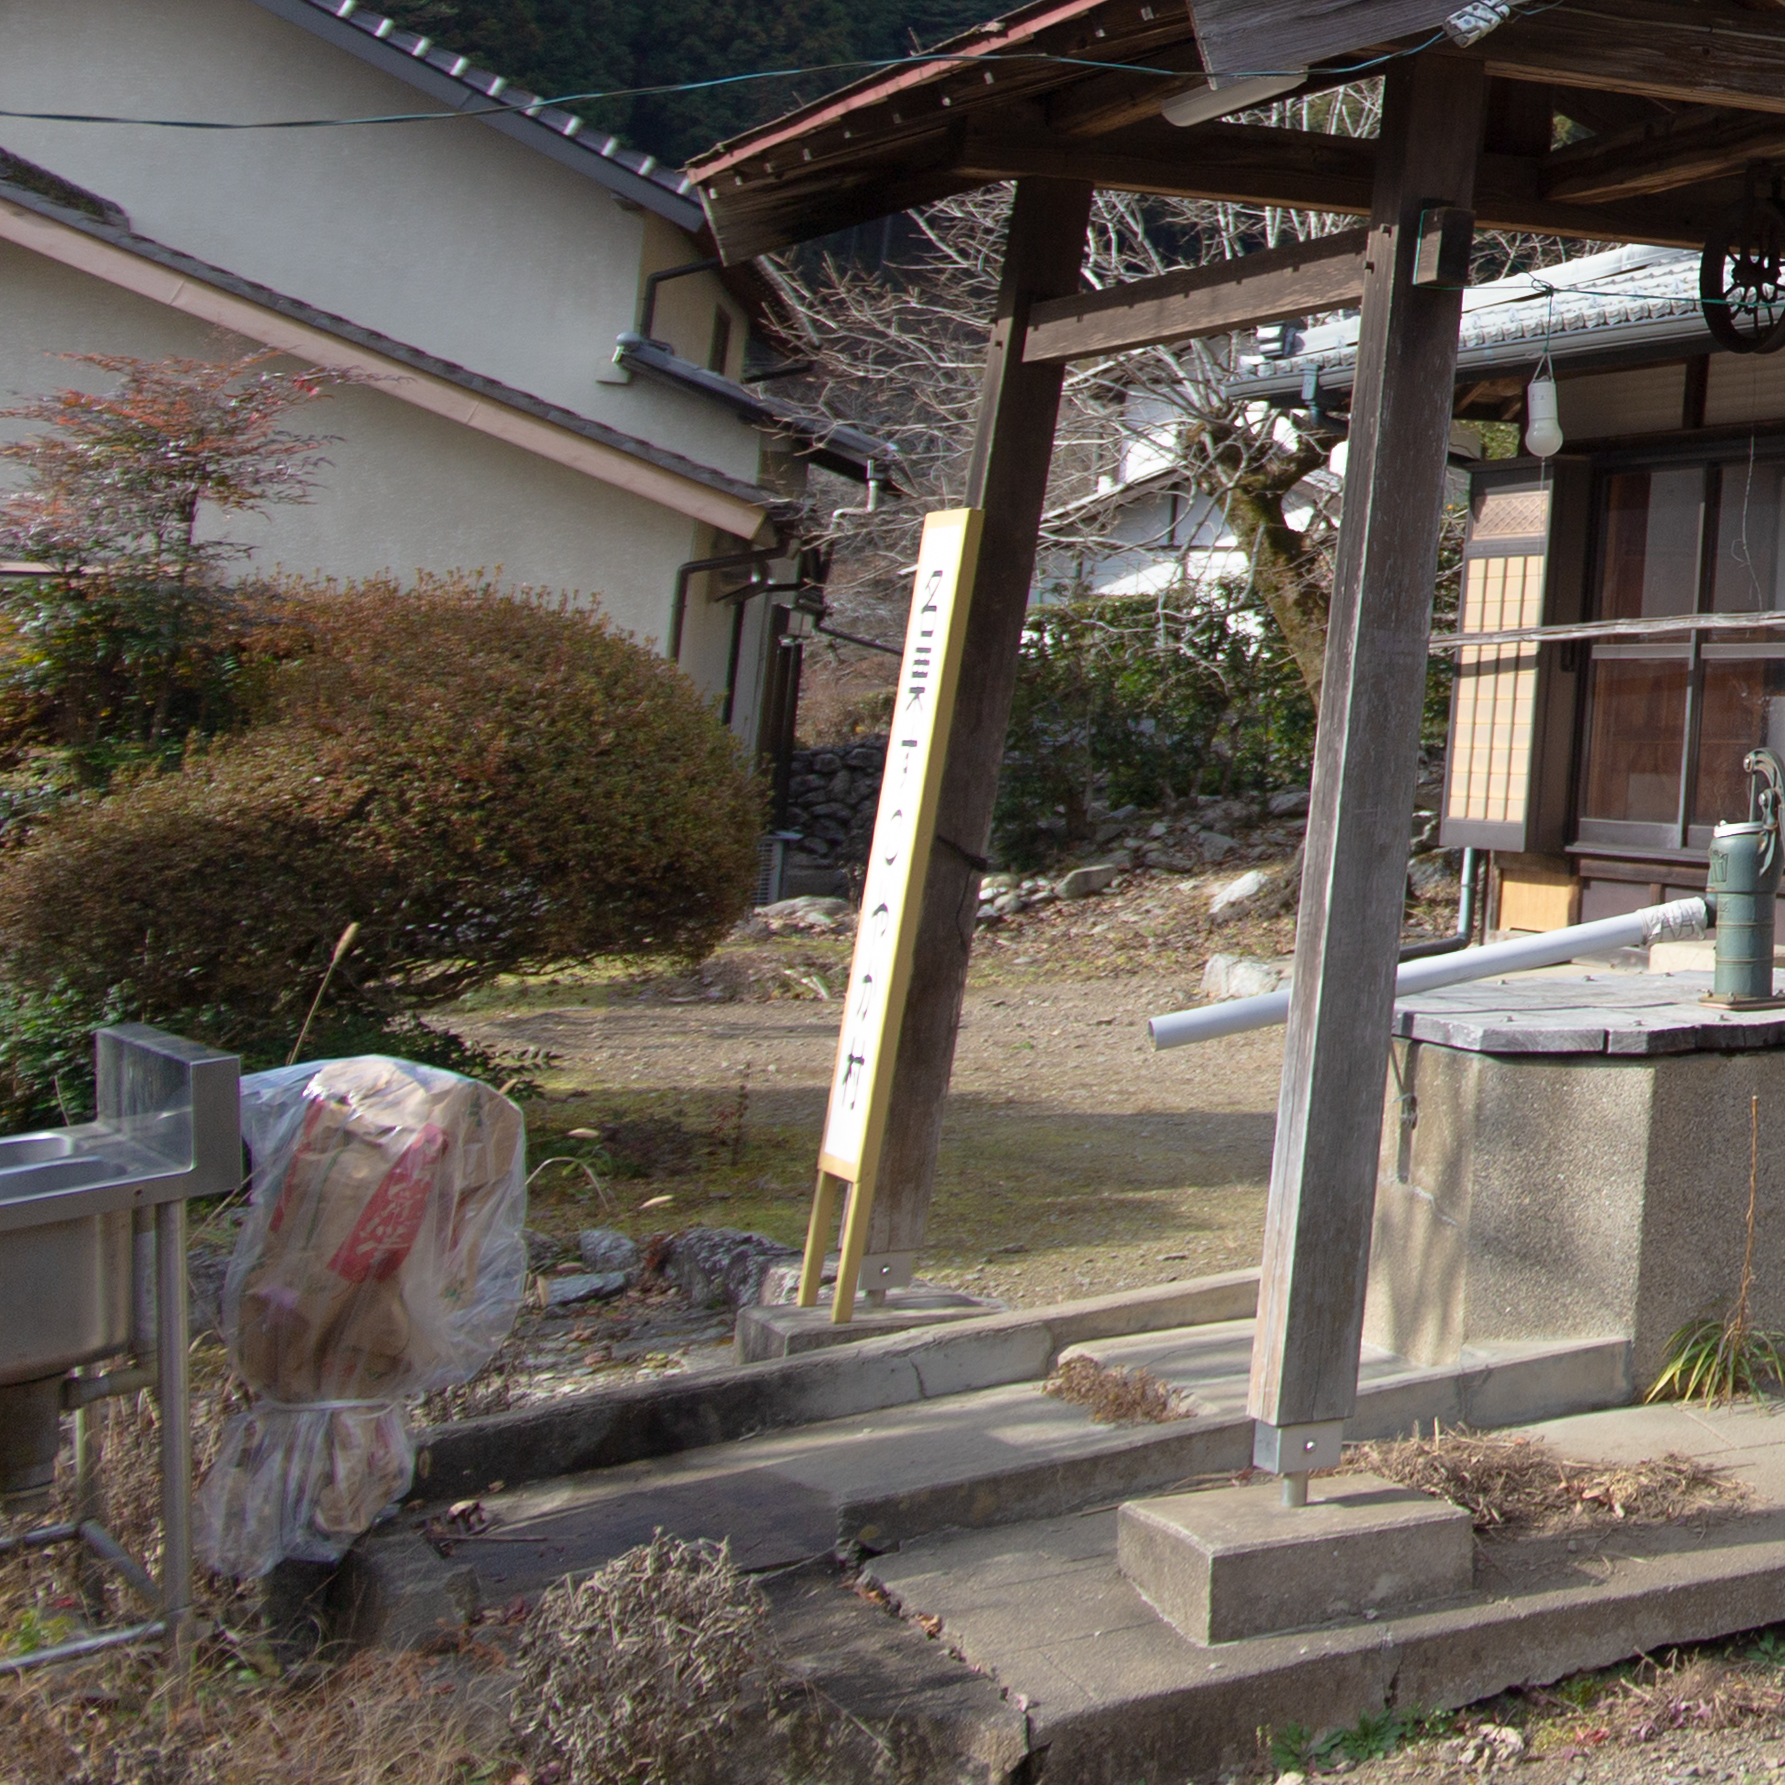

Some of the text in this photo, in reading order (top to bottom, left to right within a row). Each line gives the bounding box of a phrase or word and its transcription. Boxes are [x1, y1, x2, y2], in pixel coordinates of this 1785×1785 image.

[843, 570, 943, 1110] 名栗すこやか村
